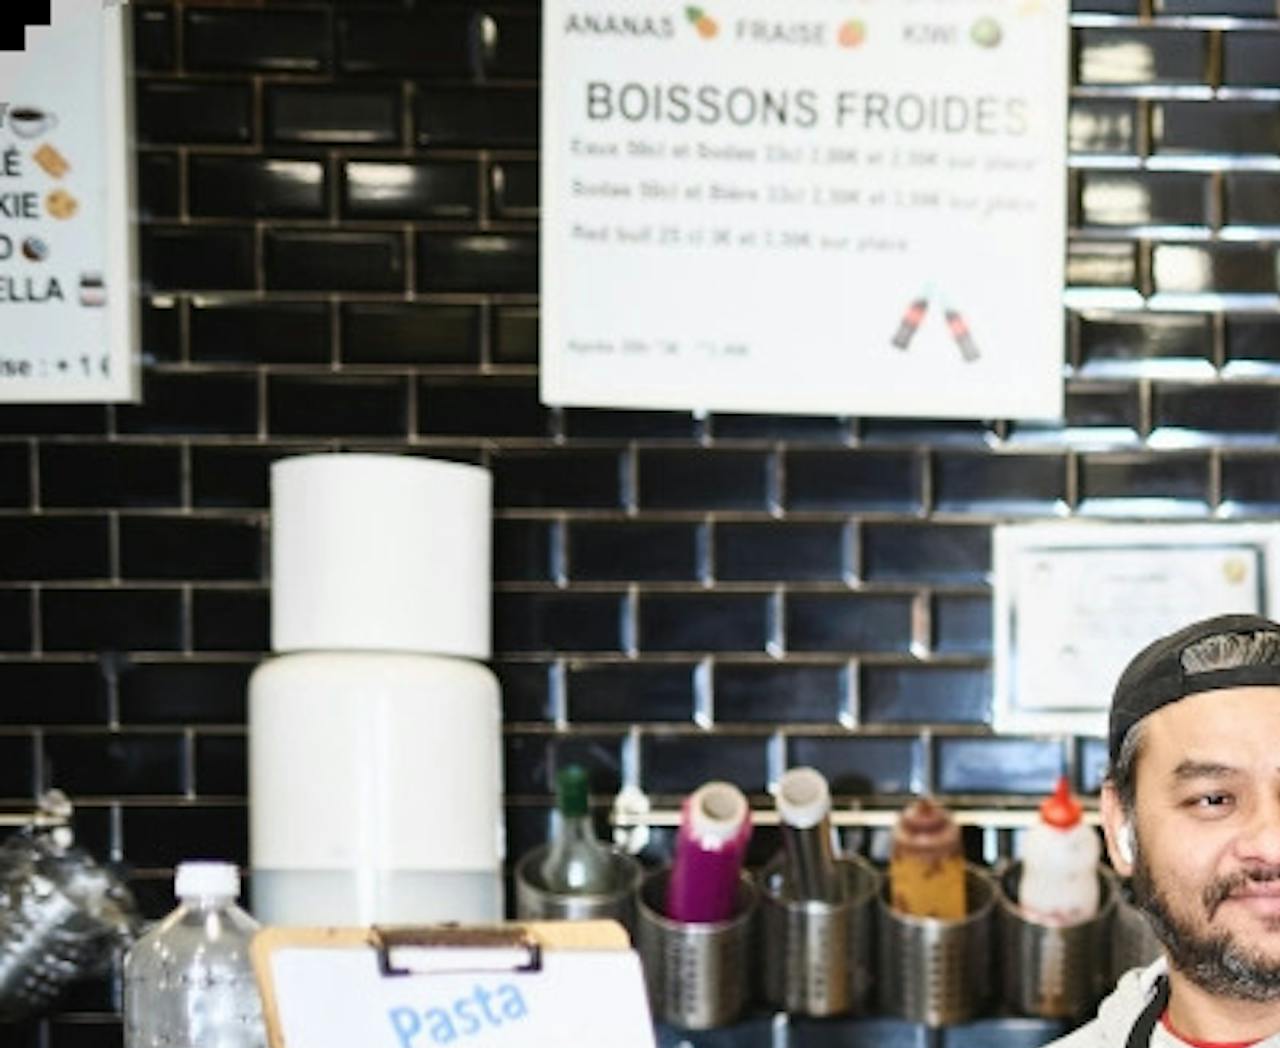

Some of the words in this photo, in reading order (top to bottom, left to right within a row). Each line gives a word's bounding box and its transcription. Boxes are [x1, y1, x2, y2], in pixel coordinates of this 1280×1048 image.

[564, 14, 674, 38] ANANAS
[586, 82, 819, 128] BOISSONS
[836, 92, 1030, 137] FROIDES
